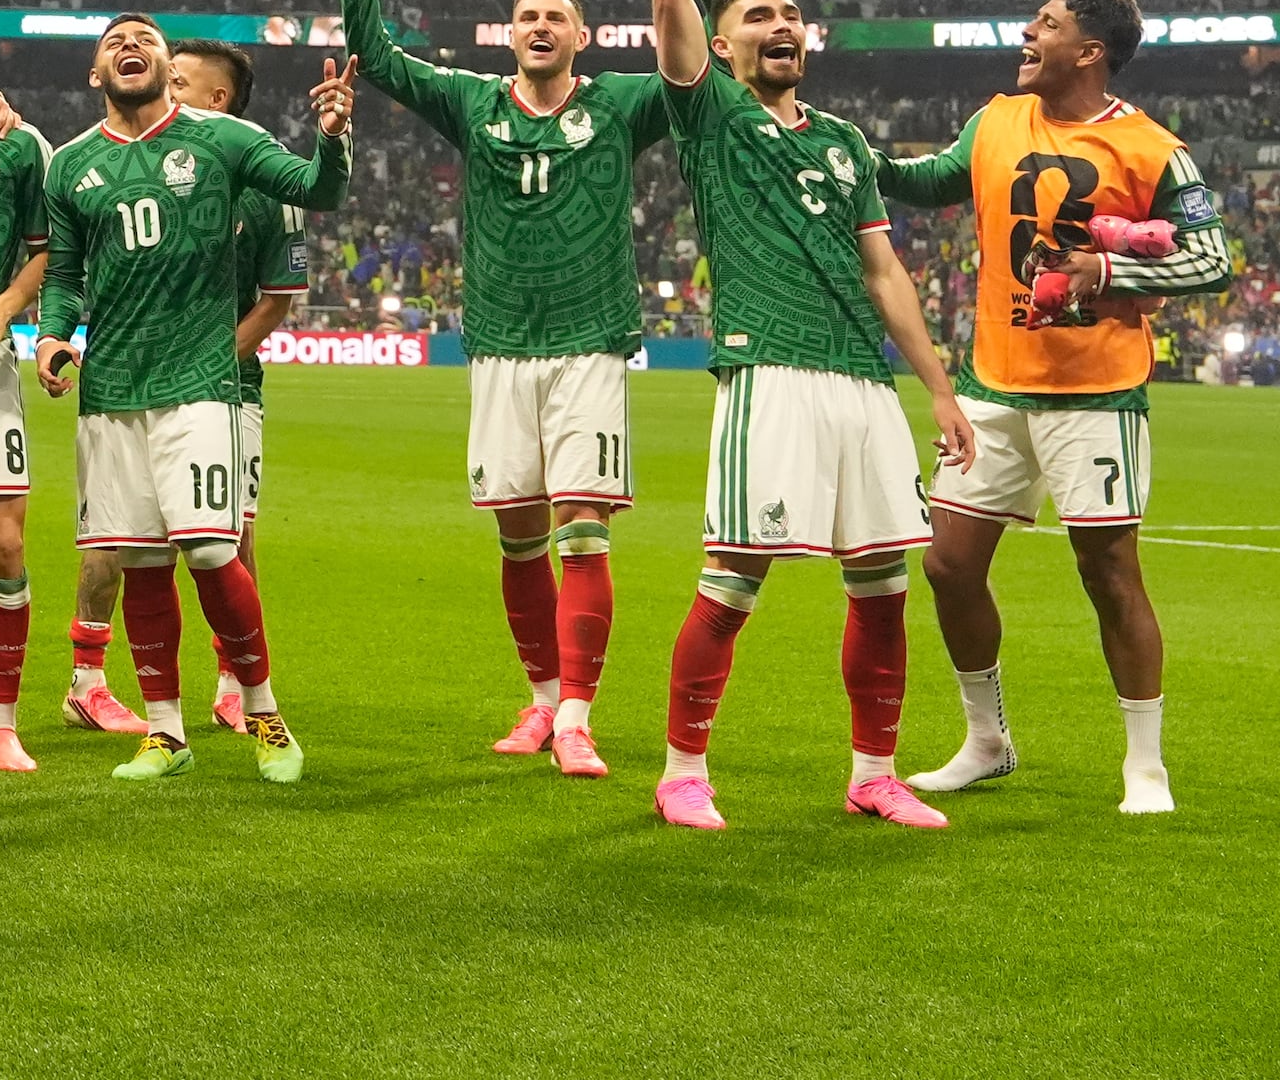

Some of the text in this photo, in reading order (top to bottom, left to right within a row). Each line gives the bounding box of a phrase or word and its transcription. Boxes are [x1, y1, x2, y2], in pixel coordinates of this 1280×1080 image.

[933, 21, 998, 47] FIFA
[520, 152, 550, 194] 11
[117, 198, 161, 251] 10
[256, 331, 423, 366] cDonald's
[5, 428, 25, 475] 8
[597, 432, 619, 479] 11
[190, 463, 228, 511] 10
[1094, 457, 1120, 505] 7
